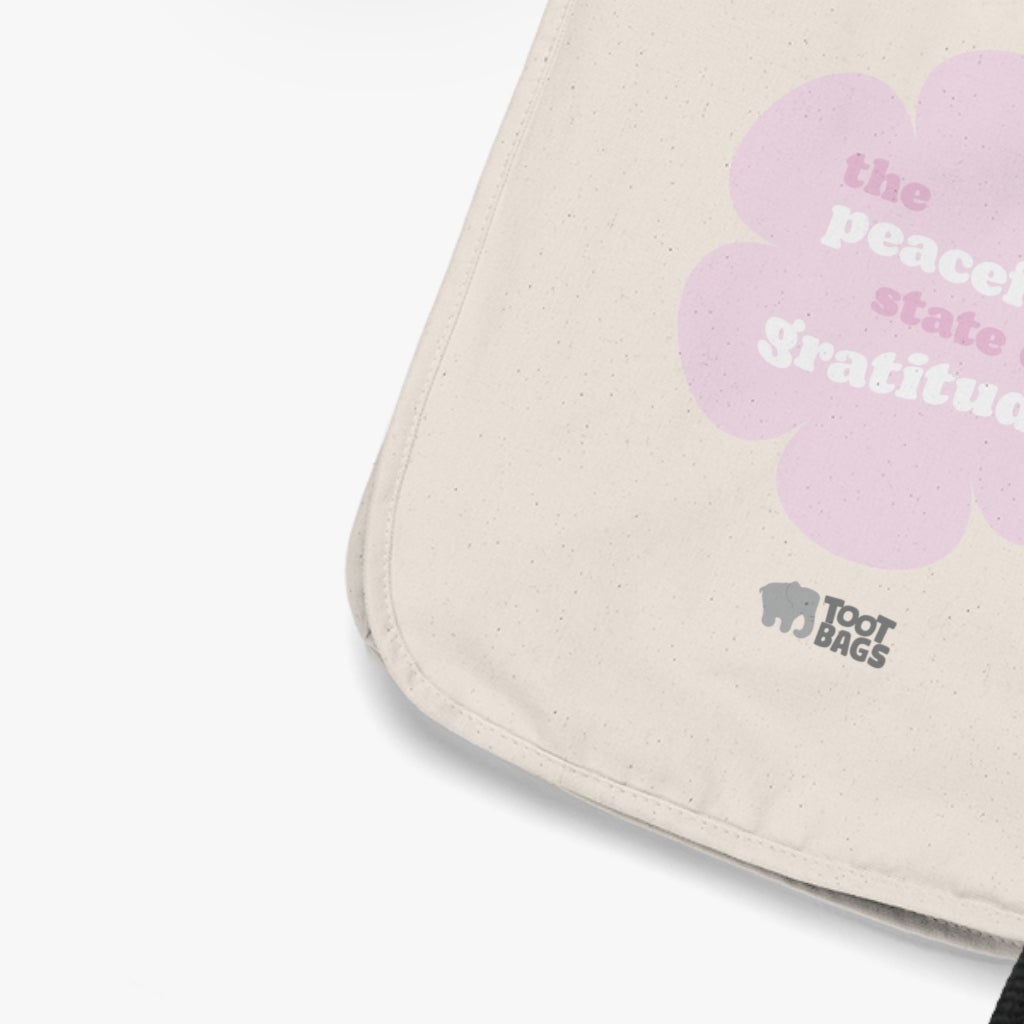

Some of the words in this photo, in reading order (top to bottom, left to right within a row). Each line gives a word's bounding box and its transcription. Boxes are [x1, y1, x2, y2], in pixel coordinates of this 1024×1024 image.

[843, 153, 931, 211] the
[871, 286, 1006, 356] state
[814, 622, 890, 668] BAGS
[823, 595, 897, 644] TOOT
